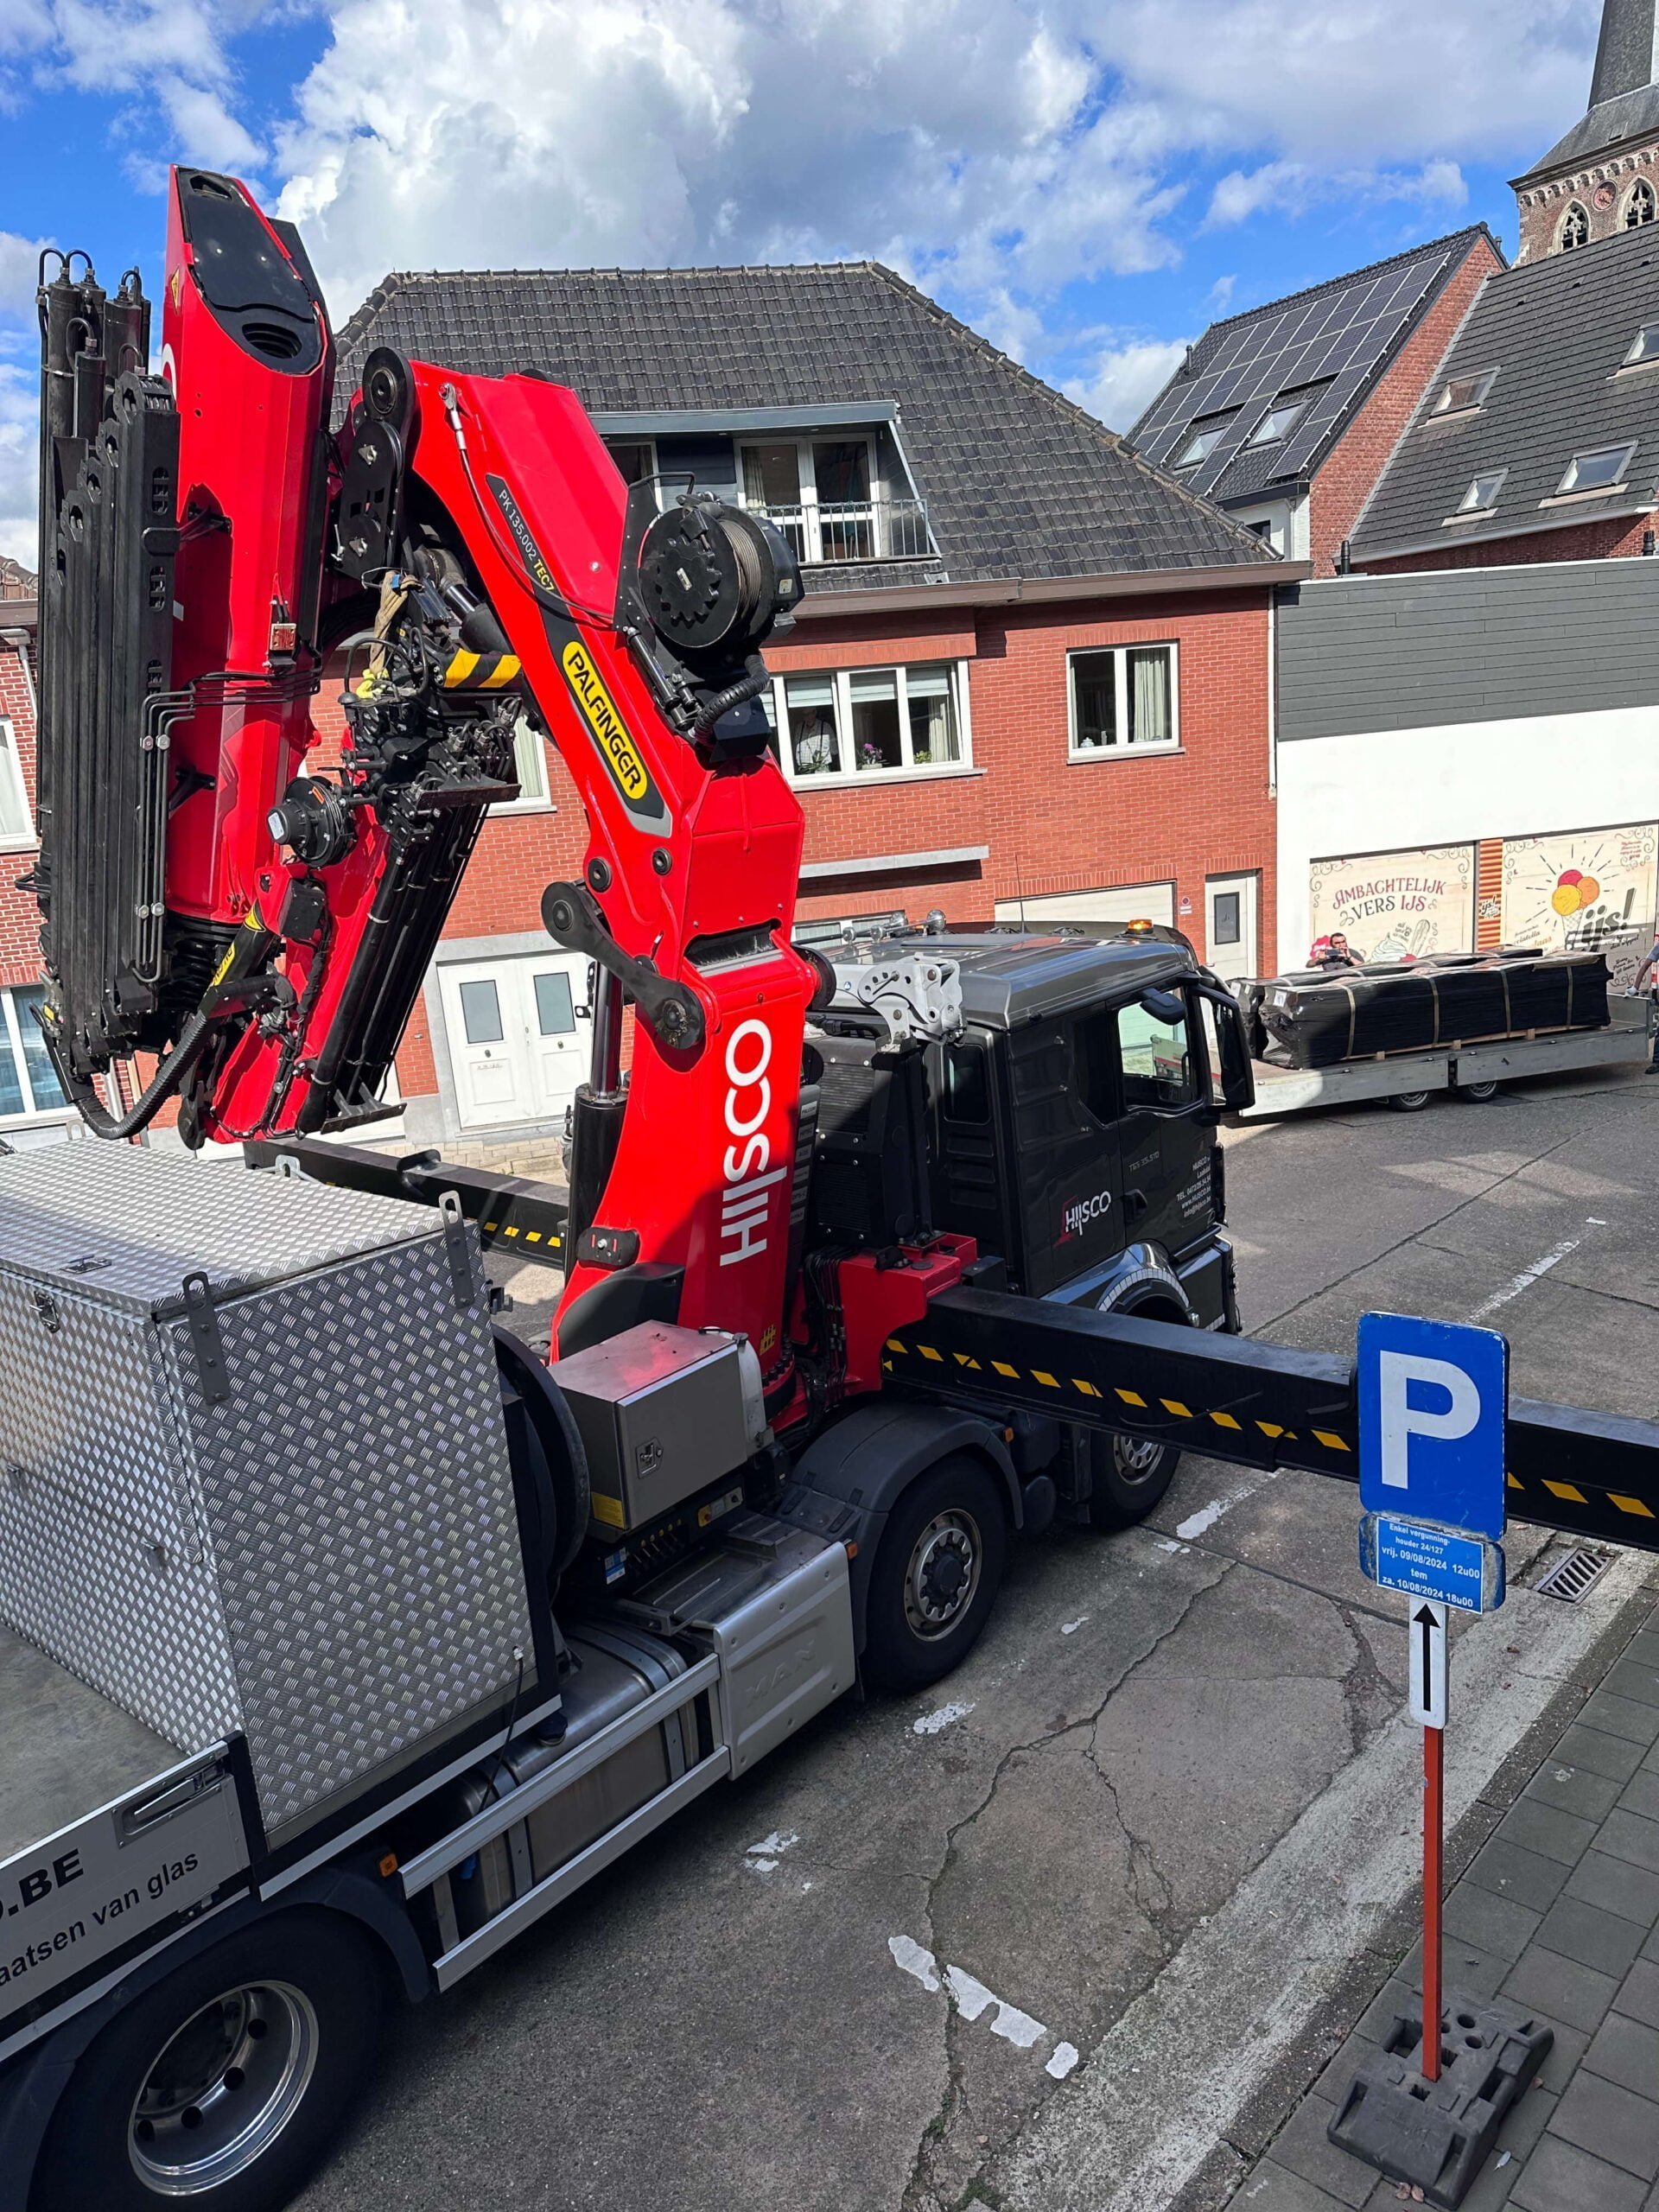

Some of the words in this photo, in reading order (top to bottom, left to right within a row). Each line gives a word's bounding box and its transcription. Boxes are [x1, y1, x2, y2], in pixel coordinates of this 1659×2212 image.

[499, 489, 512, 512] PK
[508, 508, 537, 561] 135.002
[533, 558, 555, 591] TEC7
[567, 650, 641, 791] PALFINGER
[1332, 877, 1447, 910] AMBACHTELIJK
[1351, 895, 1395, 919] VERS
[1400, 894, 1427, 912] IJS
[719, 1018, 788, 1267] HIJSCO
[1065, 1191, 1112, 1236] HIJSCO
[1380, 1350, 1481, 1490] P
[1389, 1522, 1408, 1535] Enkel
[1410, 1530, 1451, 1547] vergunning-
[1395, 1535, 1419, 1548] houder
[1421, 1542, 1444, 1555] 24/127
[1382, 1546, 1398, 1559] vrij.
[1400, 1550, 1447, 1571] 09/08/2024
[1452, 1563, 1480, 1580] 12u00
[1410, 1567, 1428, 1580] tem
[1382, 1576, 1395, 1586] za.
[1396, 1579, 1444, 1599] 10/08/2024
[1446, 1592, 1473, 1608] 18u00
[0, 1847, 85, 1921] .BE
[92, 1887, 140, 1926] van
[147, 1853, 199, 1900] glas
